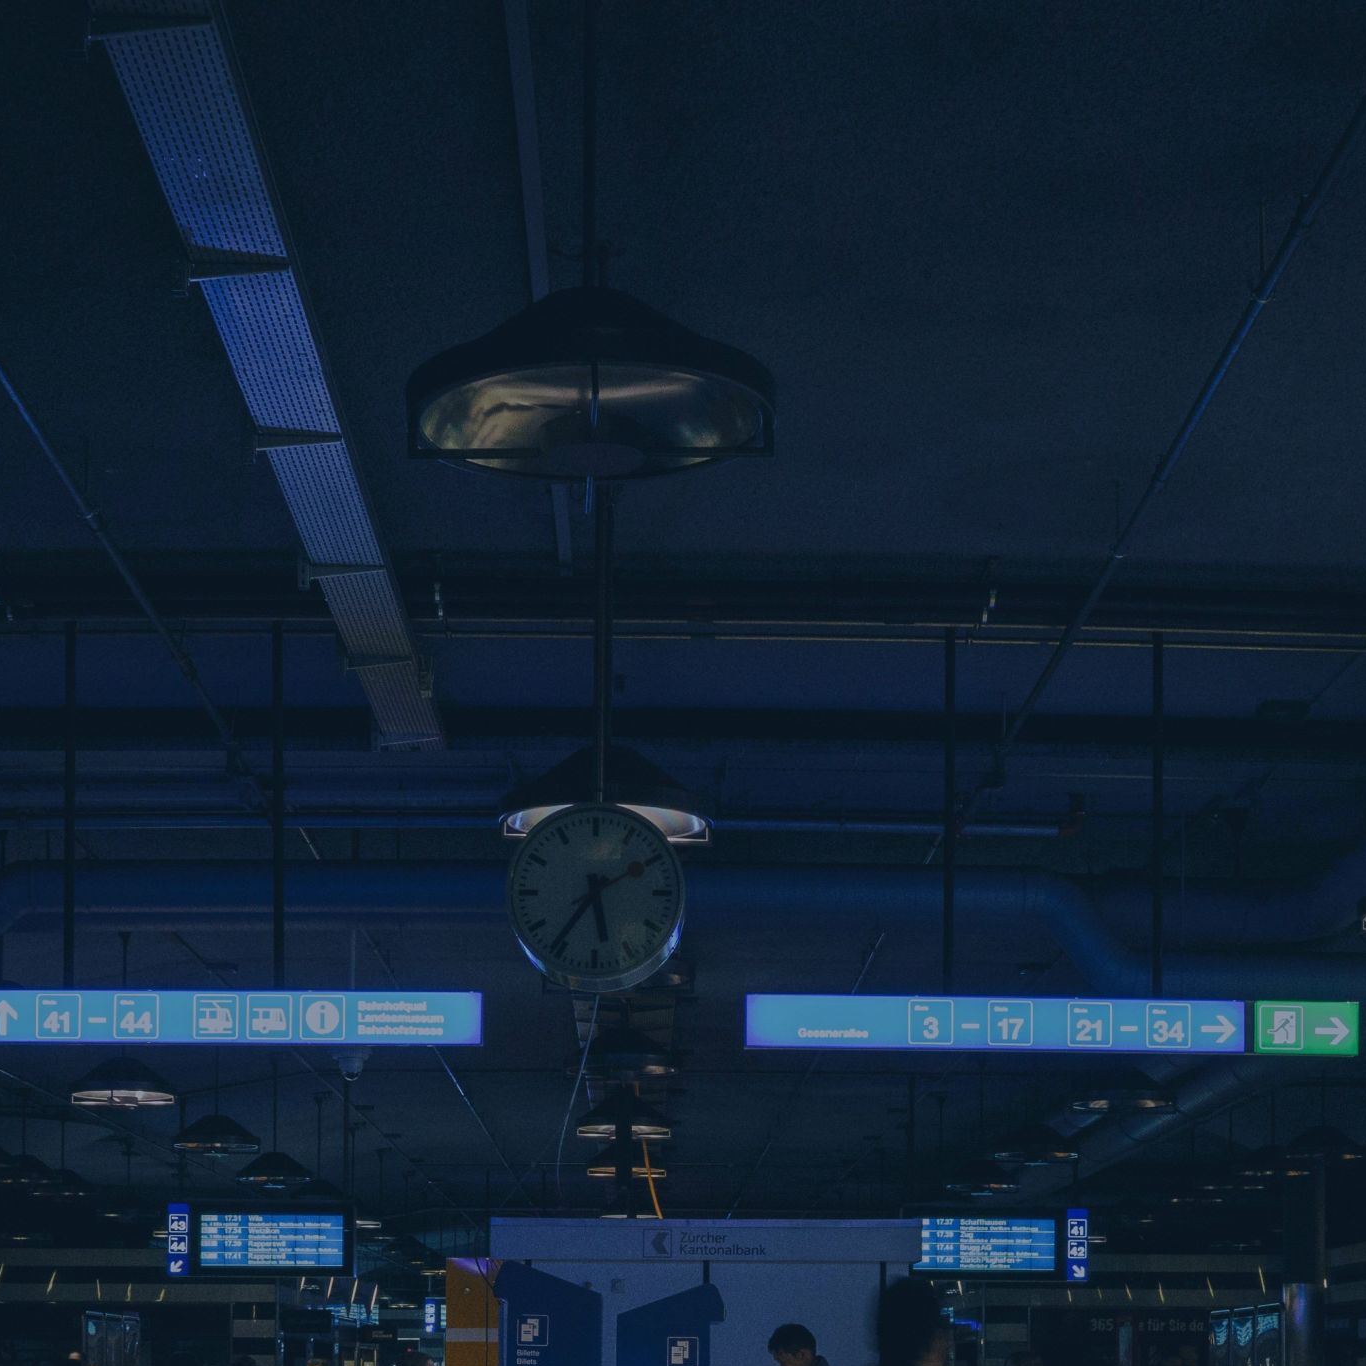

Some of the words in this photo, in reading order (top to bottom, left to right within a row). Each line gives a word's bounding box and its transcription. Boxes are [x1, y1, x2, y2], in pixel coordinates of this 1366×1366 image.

[43, 1011, 71, 1033] 41
[120, 1011, 153, 1034] 44
[923, 1016, 940, 1040] 3
[997, 1018, 1025, 1041] 17
[1076, 1019, 1103, 1041] 21
[1152, 1020, 1185, 1043] 34
[171, 1220, 186, 1230] 43
[1070, 1225, 1084, 1235] 41
[171, 1241, 186, 1251] 44
[680, 1244, 766, 1255] Kantonalbank
[1070, 1247, 1085, 1257] 42
[1091, 1318, 1115, 1331] 365
